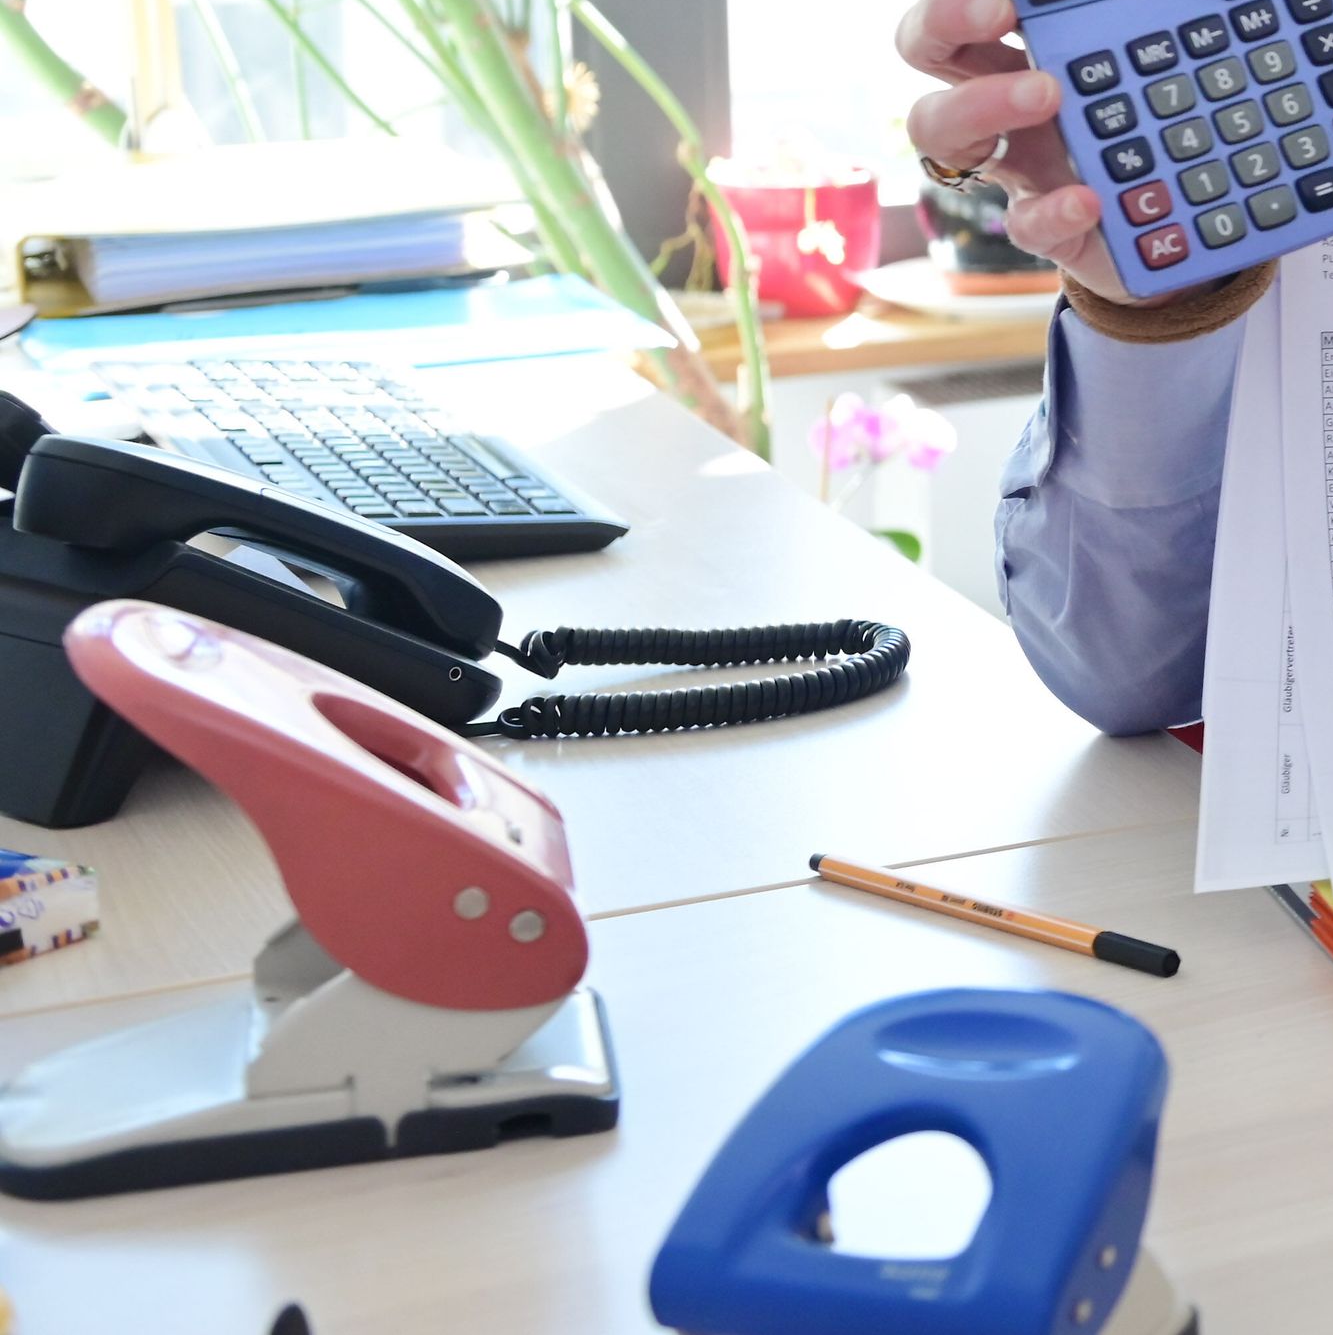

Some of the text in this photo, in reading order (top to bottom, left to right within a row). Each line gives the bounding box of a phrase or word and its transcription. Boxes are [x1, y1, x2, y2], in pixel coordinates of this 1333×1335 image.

[1239, 8, 1272, 32] M+
[1136, 40, 1175, 65] MRC
[1263, 51, 1282, 73] 9
[1080, 60, 1114, 83] ON
[1213, 68, 1234, 90] 8
[1162, 83, 1178, 107] 7
[1281, 93, 1300, 115] 6
[1232, 110, 1251, 134] 5
[1181, 127, 1200, 148] 4
[1297, 136, 1317, 159] 3
[1116, 147, 1144, 171] %
[1247, 153, 1268, 177] 2
[1198, 172, 1214, 193] 1
[1138, 191, 1161, 215] C
[1214, 214, 1233, 236] 0
[1151, 233, 1182, 259] AC
